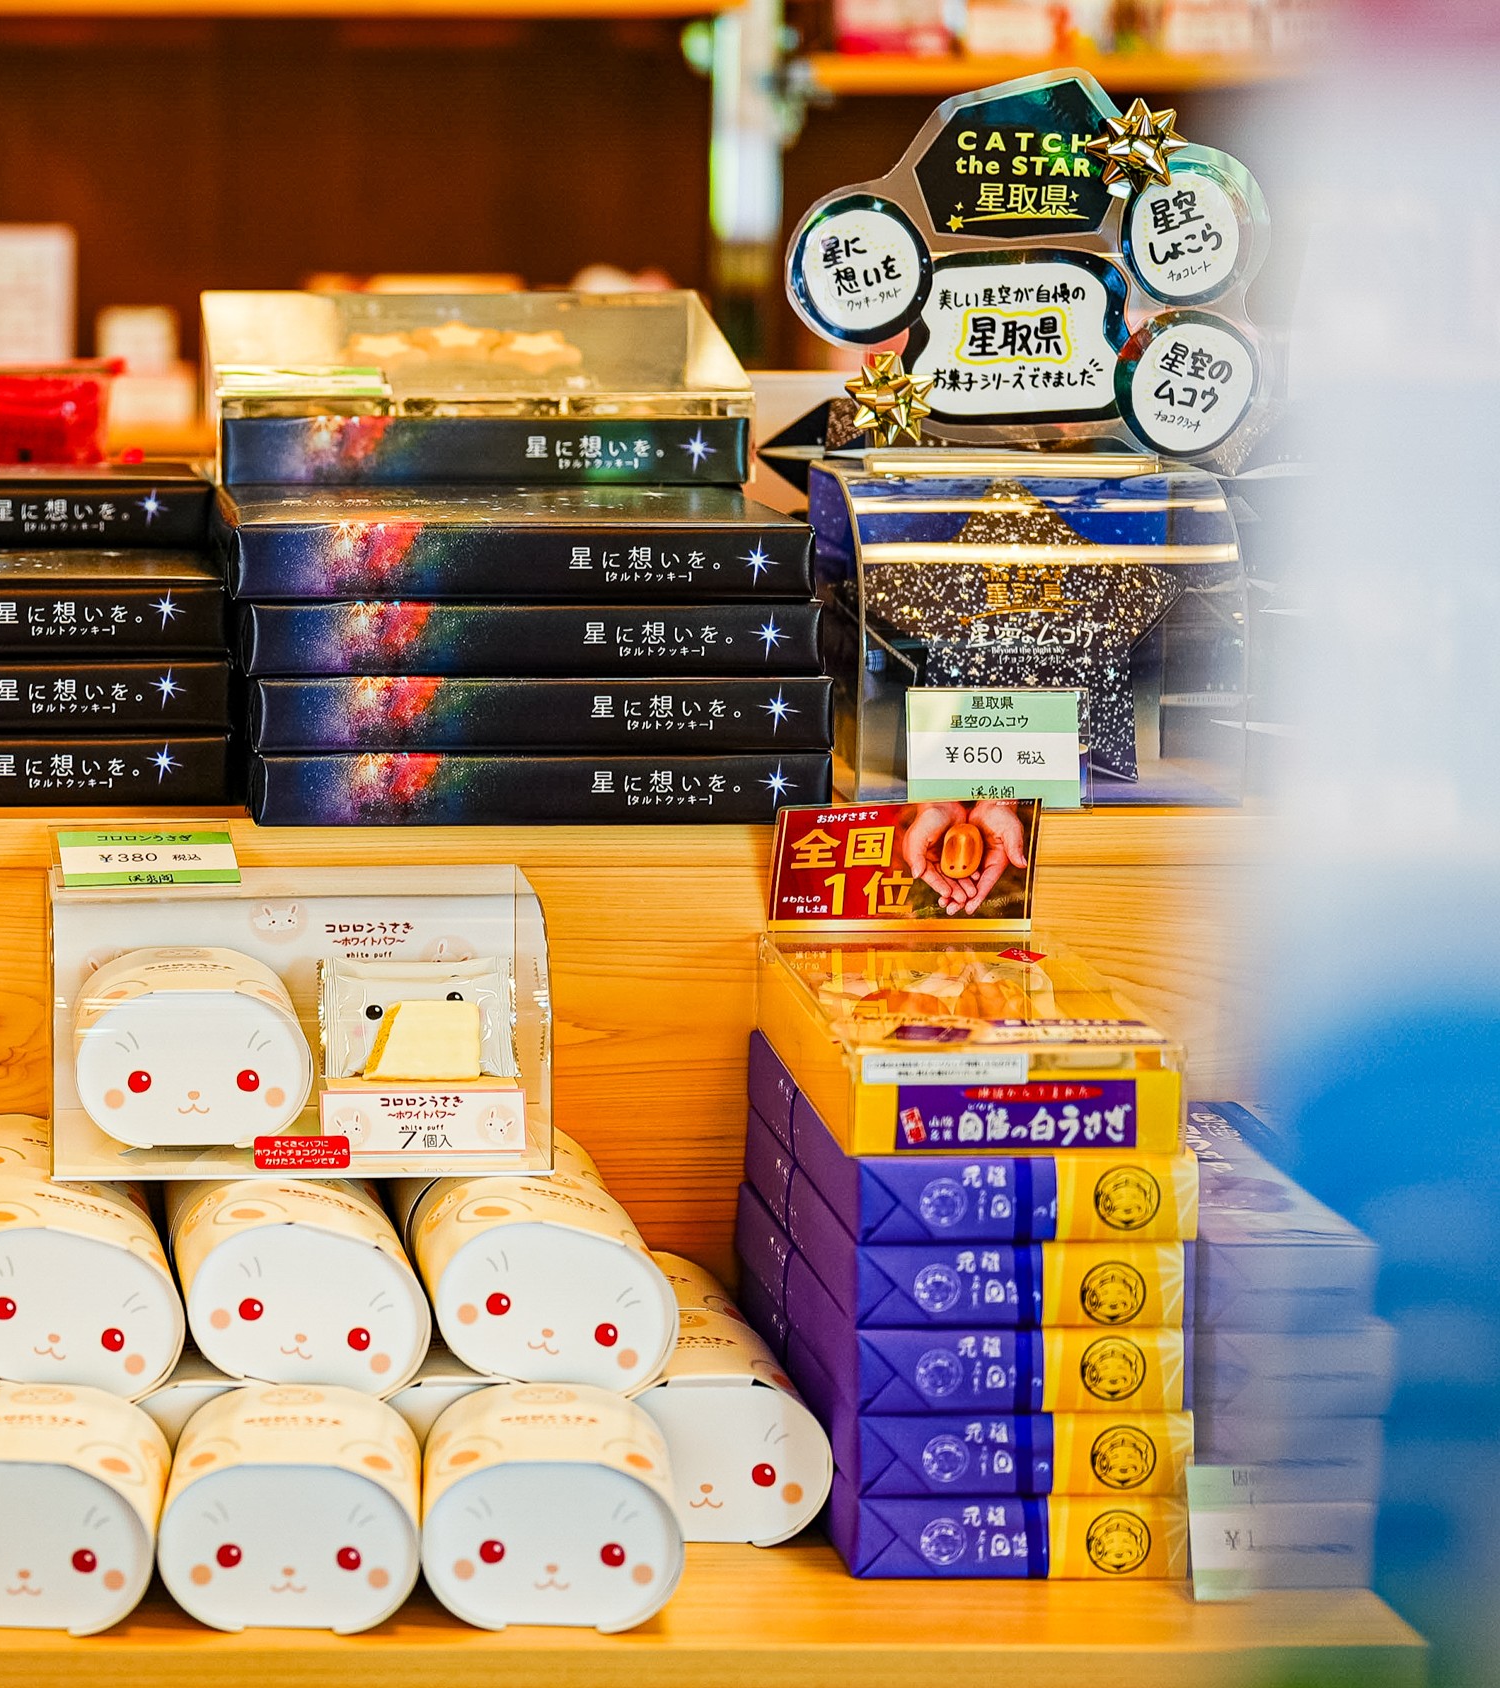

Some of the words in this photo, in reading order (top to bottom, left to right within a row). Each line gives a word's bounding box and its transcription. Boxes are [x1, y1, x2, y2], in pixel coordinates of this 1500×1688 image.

[957, 131, 1092, 153] CATCH
[955, 156, 1000, 177] the
[1011, 157, 1091, 178] STAR
[975, 182, 1071, 216] 星取県
[1150, 189, 1206, 232] 星空
[821, 234, 868, 269] 星に
[1148, 222, 1225, 267] しょこら
[834, 254, 903, 298] 想いを
[939, 284, 1086, 311] 美しい星空が自慢の
[967, 315, 1063, 358] 星取県
[1160, 340, 1234, 386] 星空の
[932, 366, 1096, 393] お菓子シリーズできました
[1153, 383, 1220, 414] ムコウ
[569, 547, 723, 572] 星に想いを。
[582, 621, 735, 646] 星に想いを。
[966, 621, 1095, 649] 星空のムコウ
[591, 695, 743, 719] 星に想いを。
[971, 696, 1014, 710] 星取県
[949, 714, 1029, 729] 星空のムコウ
[945, 746, 1003, 765] ¥650
[1017, 750, 1046, 766] 税込
[591, 770, 743, 795] 星に想いを。
[817, 810, 879, 824] おかげさまで
[97, 834, 193, 842] コロロンうさぎ
[790, 826, 895, 870] 全国
[98, 852, 158, 863] ¥380
[172, 853, 202, 862] 税込
[823, 870, 914, 916] 1位
[795, 904, 828, 914] 推し土産
[324, 922, 414, 935] コロロンうさぎ
[346, 951, 369, 959] white
[373, 951, 392, 959] puff
[379, 1095, 464, 1108] コロロンうさぎ
[426, 1124, 445, 1132] puff
[254, 1148, 350, 1158] ホワイトチョコクリームを
[264, 1157, 341, 1166] かけたスイーツです。
